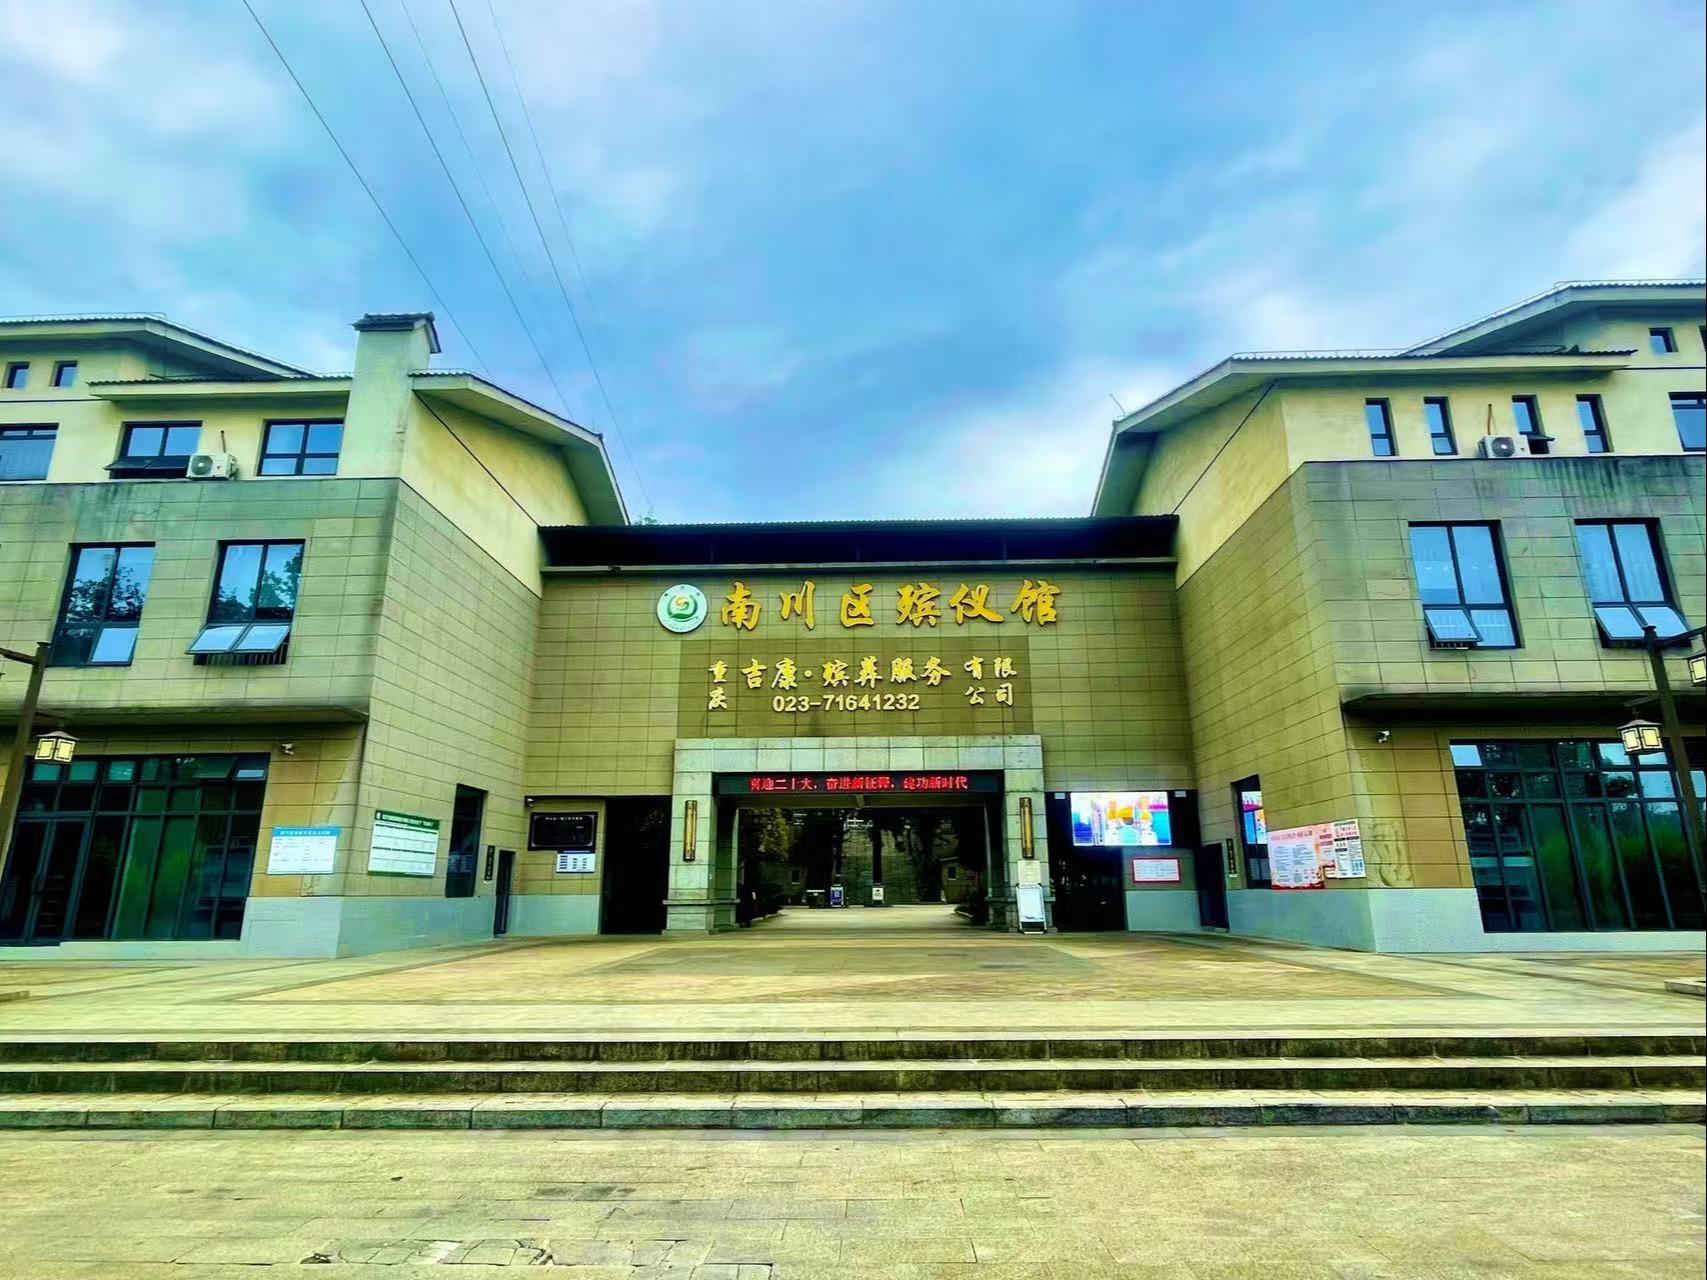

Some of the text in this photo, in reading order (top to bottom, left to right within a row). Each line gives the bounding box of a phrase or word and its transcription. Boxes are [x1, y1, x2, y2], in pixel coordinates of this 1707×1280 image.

[720, 581, 1062, 630] 南川区殡仪馆
[772, 694, 920, 712] 023-71641232
